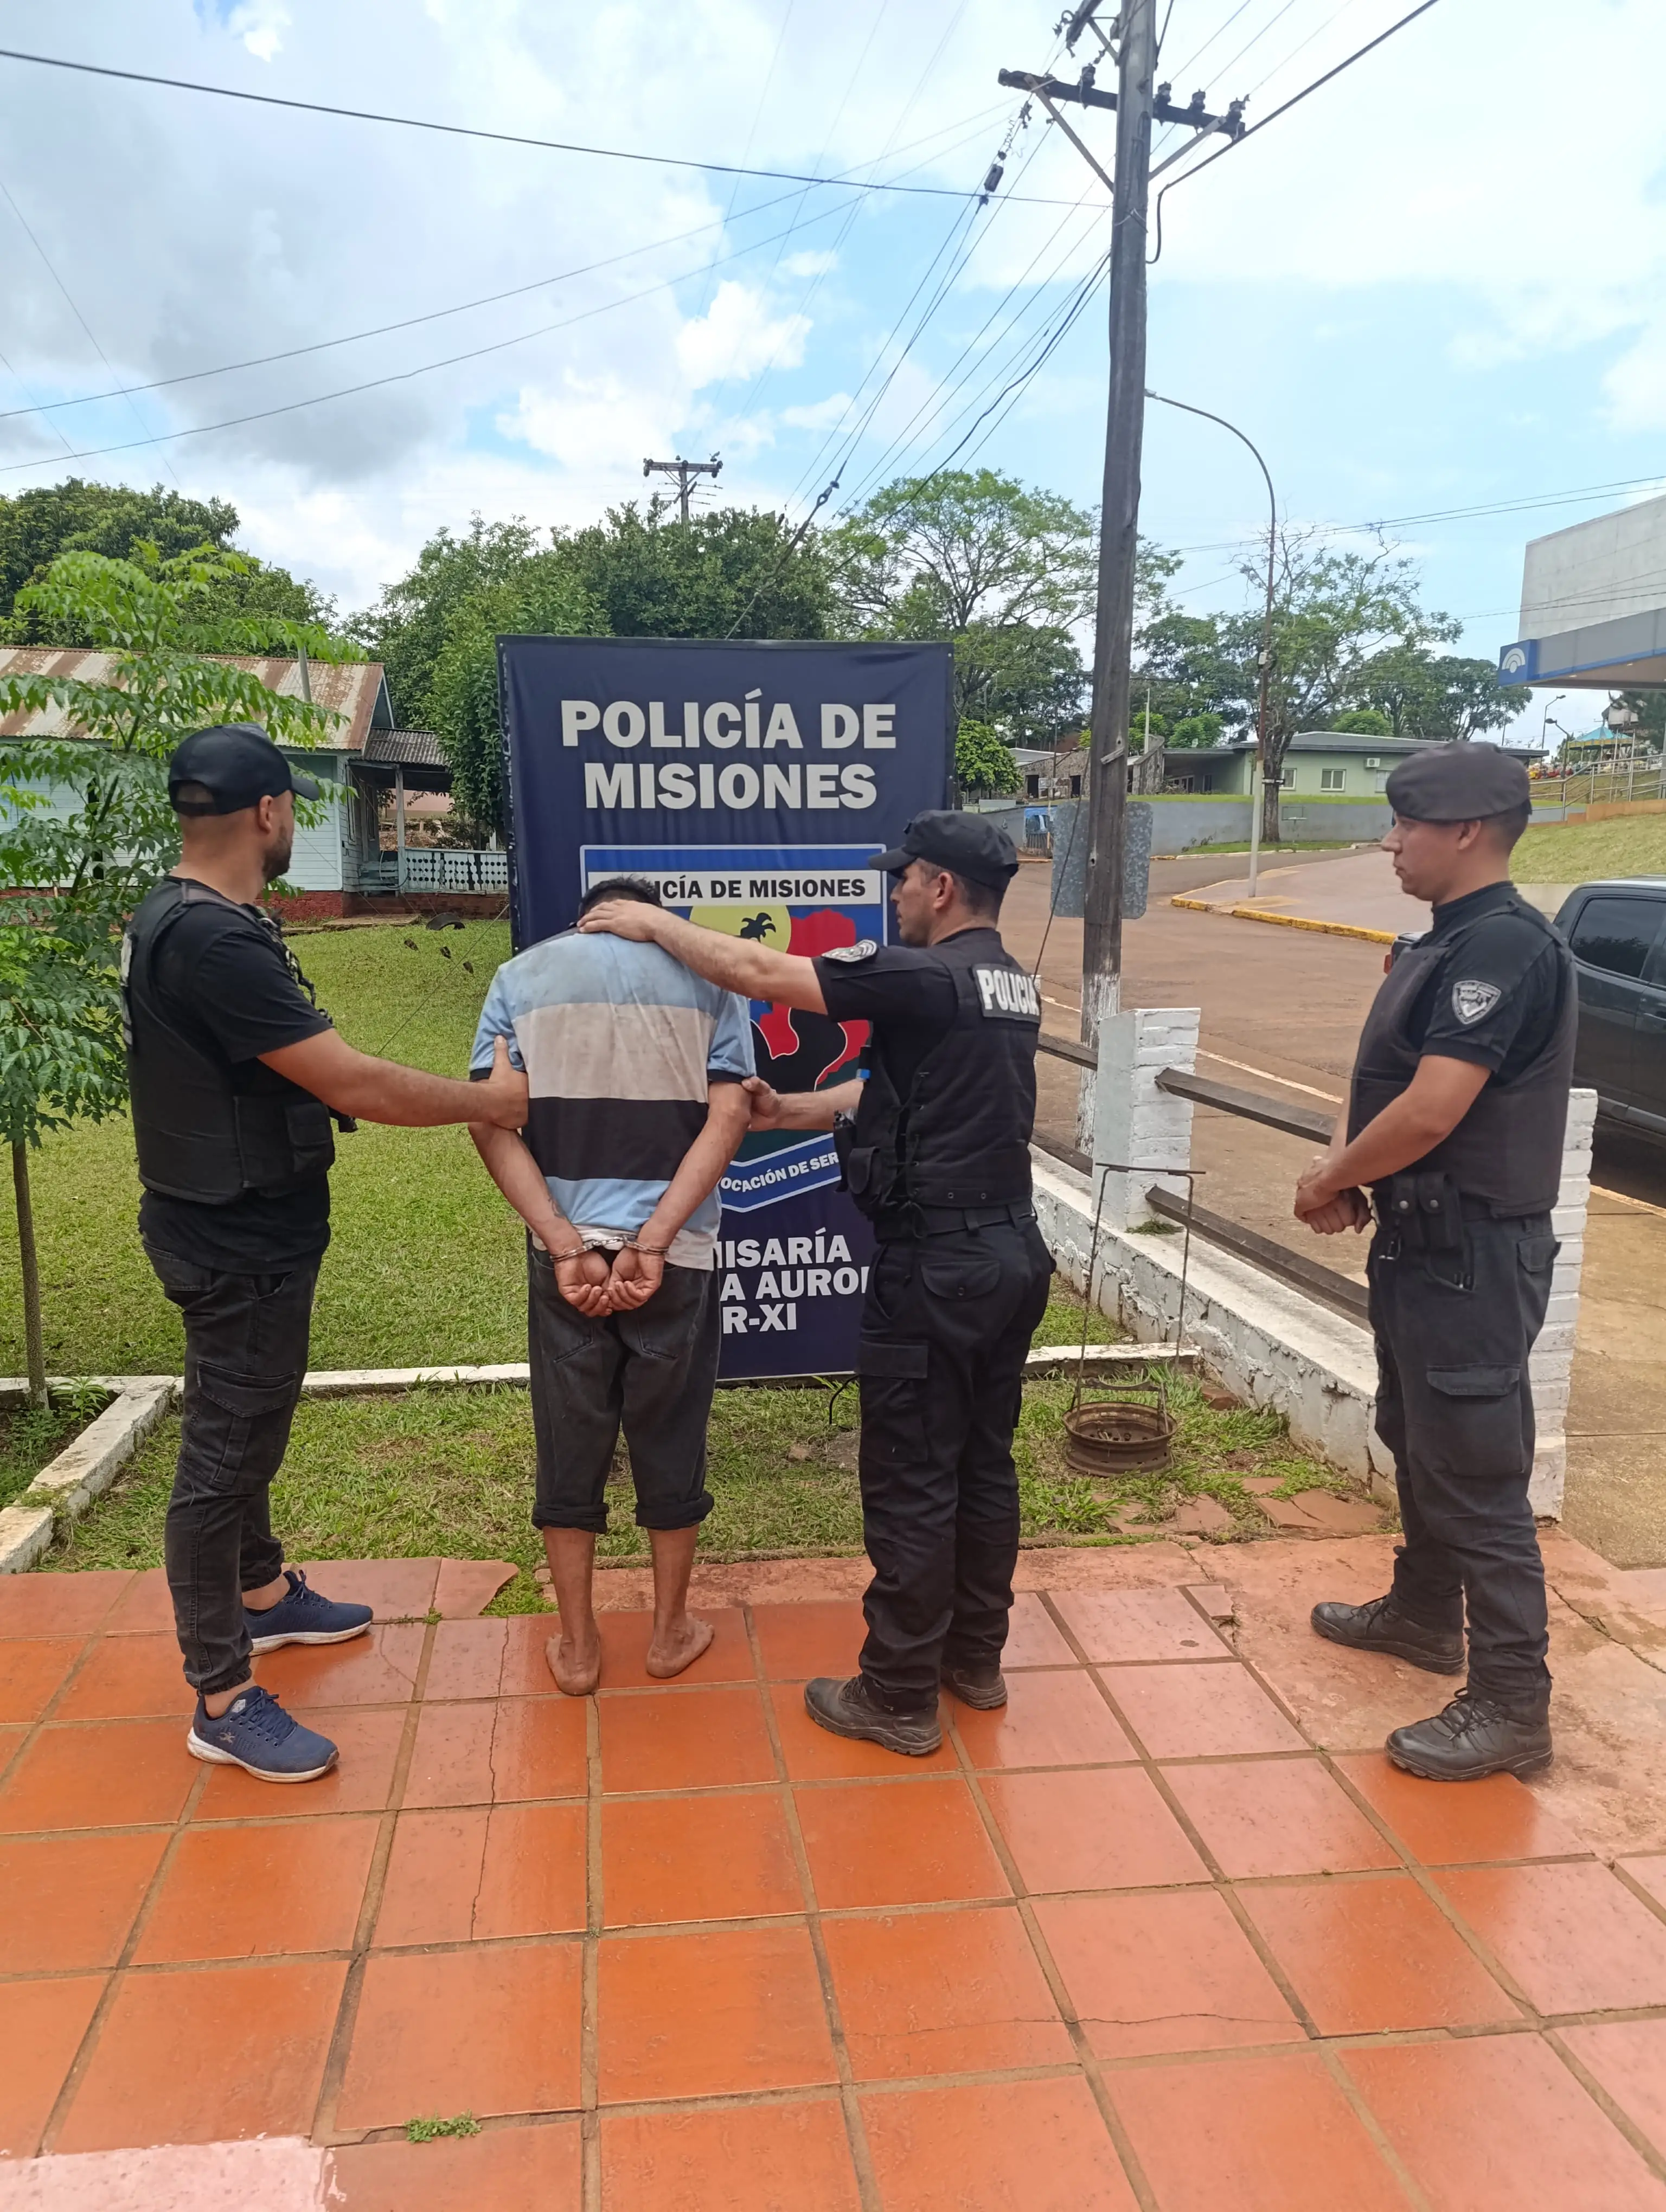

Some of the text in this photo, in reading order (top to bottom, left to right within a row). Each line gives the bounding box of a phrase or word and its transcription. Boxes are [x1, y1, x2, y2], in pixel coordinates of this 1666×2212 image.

[561, 688, 896, 749] POLICÍA DE
[584, 763, 877, 809] MISIONES
[654, 874, 866, 898] ICÍA DE MISIONES
[976, 969, 1040, 1017] POLICIA
[720, 1152, 840, 1193] OCACIÓN DE SER
[716, 1227, 853, 1269] ISARÍA
[720, 1273, 746, 1301] A
[722, 1303, 797, 1334] R-XI
